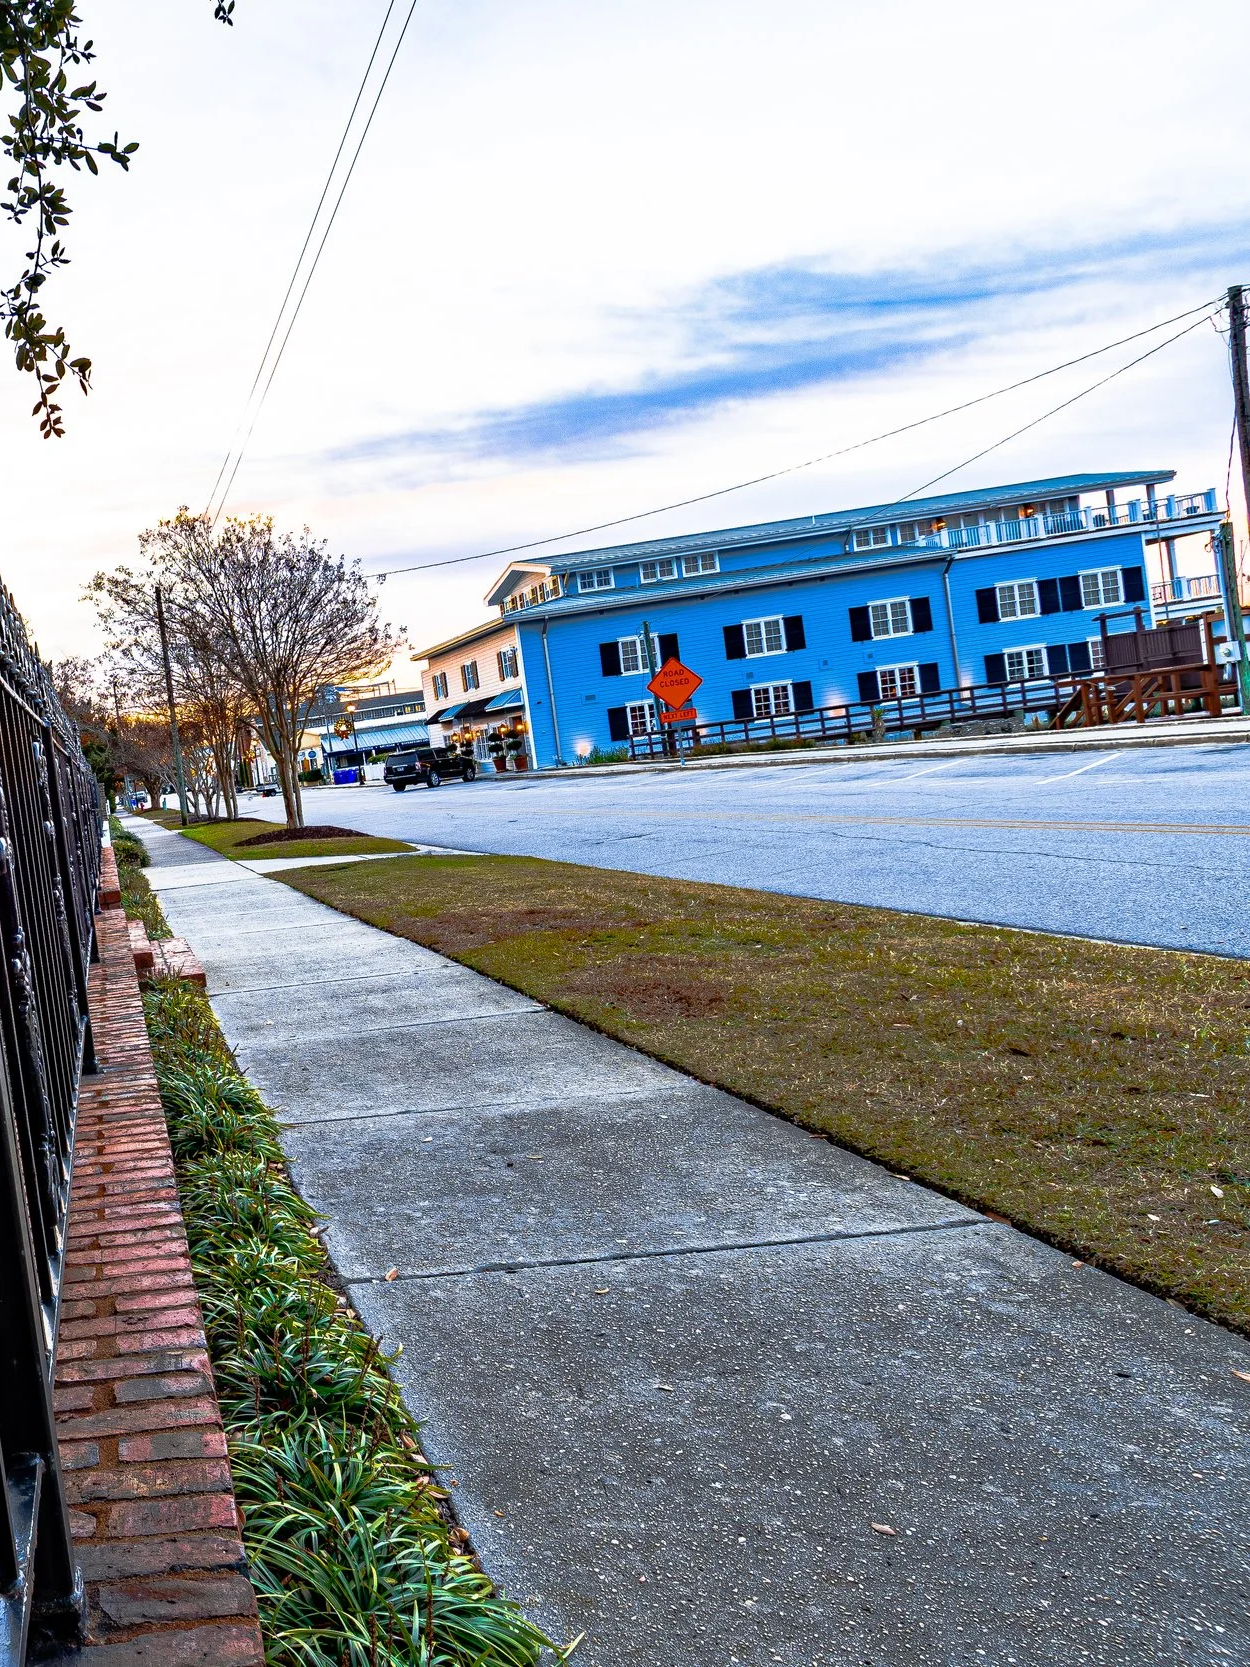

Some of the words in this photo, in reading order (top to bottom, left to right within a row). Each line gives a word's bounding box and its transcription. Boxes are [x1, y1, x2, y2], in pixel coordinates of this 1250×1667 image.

[663, 669, 685, 678] ROAD
[660, 678, 690, 688] CLOSED
[663, 712, 678, 720] NEXT
[680, 710, 694, 718] LEFT
